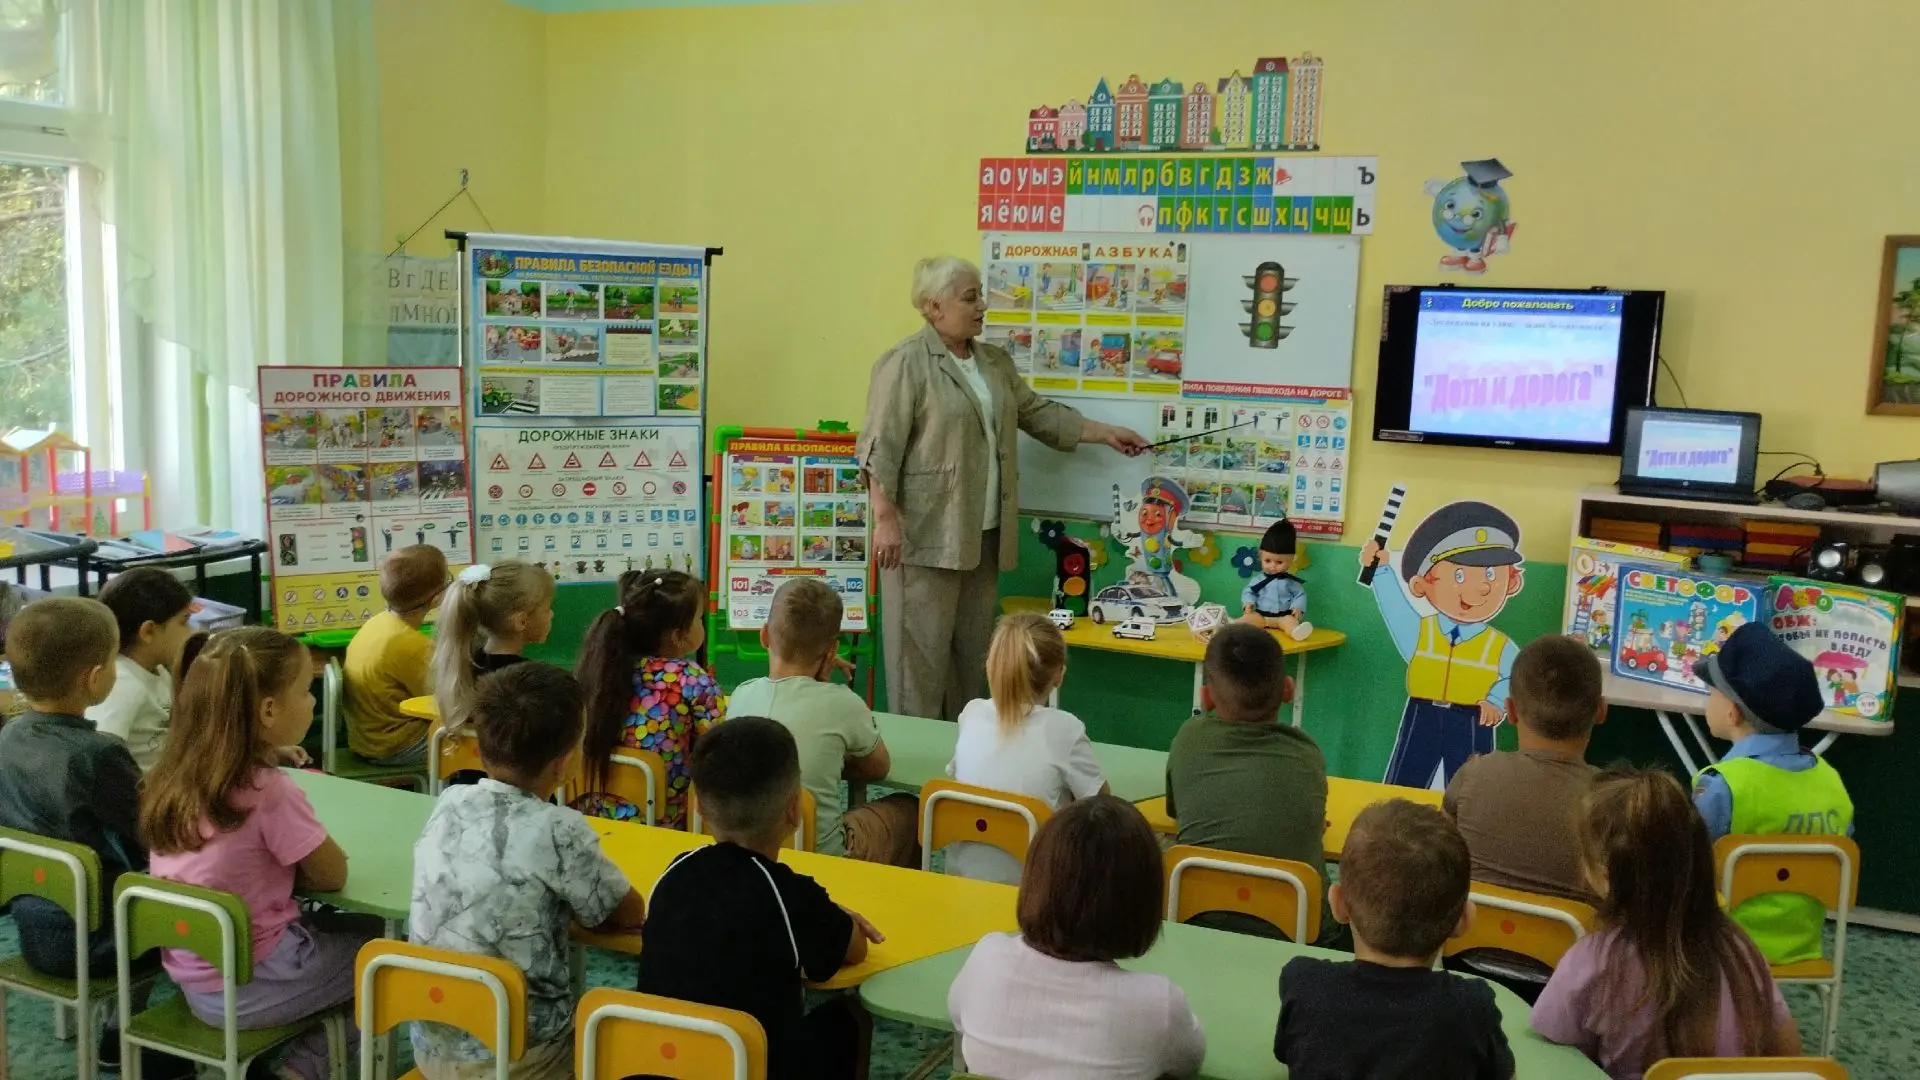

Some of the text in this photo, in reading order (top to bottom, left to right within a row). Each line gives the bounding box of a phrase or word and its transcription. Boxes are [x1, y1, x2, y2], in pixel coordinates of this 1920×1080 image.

[1004, 245, 1173, 259] ДОРОЖНАЯ АЗБУКА
[514, 256, 575, 272] ПРАВИЛА
[579, 260, 655, 275] БЕЗОПАСНОЙ
[1462, 298, 1574, 311] Добро пожаловать
[313, 374, 417, 388] ПРАВИЛА
[274, 390, 451, 403] ДОРОЖНОГО ДВИЖЕНИЯ
[1310, 390, 1343, 398] ДОРОГЕ
[1493, 376, 1507, 405] и
[518, 429, 660, 443] ДОРОЖНЫЕ ЗНАКИ
[730, 442, 781, 451] ПРАВИЛА
[1628, 571, 1751, 605] СВЕТОФОР
[733, 608, 749, 617] 103
[1834, 630, 1887, 650] ПОПАСТЬ
[1842, 644, 1872, 658] БЕДУ
